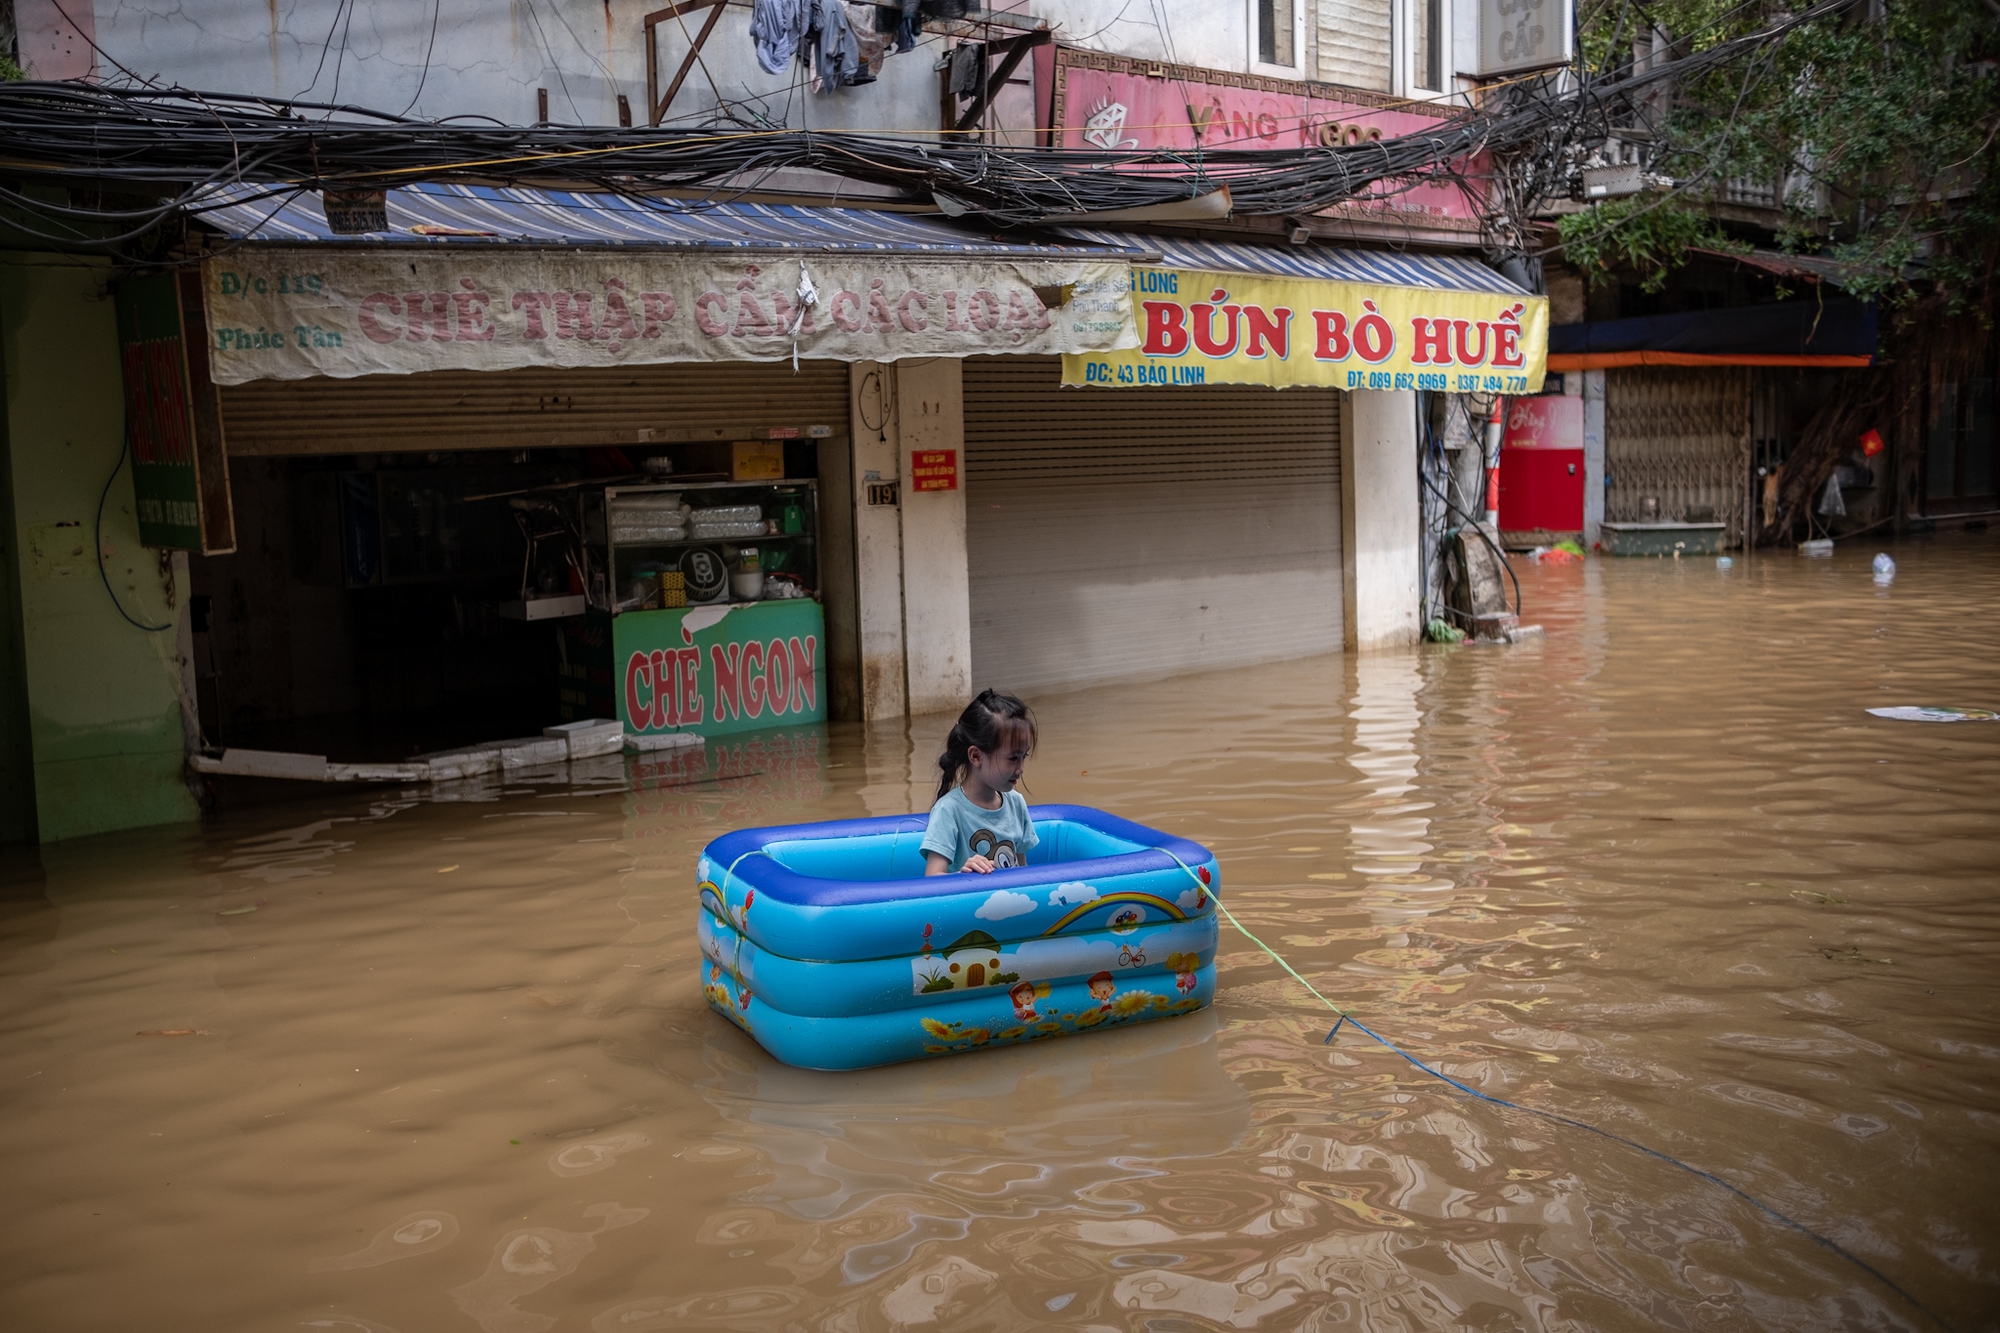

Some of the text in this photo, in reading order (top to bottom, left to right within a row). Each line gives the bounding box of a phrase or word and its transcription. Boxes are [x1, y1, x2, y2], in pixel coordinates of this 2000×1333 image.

[220, 272, 267, 299] Đ/c
[1140, 271, 1178, 294] LONG
[358, 276, 496, 343] CHÈ
[512, 276, 676, 354] THẬP
[831, 277, 928, 334] CÁC
[217, 325, 343, 350] Phúc Tân
[1141, 287, 1526, 370] BÚN BÒ HUẾ
[1086, 359, 1205, 384] ĐC: 43 BẢO LINH
[1348, 371, 1366, 388] ĐT:
[1369, 371, 1391, 389] 089
[1395, 373, 1414, 389] 662
[1418, 374, 1447, 389] 9969
[1458, 375, 1480, 390] 0387
[1483, 376, 1502, 391] 484
[1507, 376, 1527, 391] 770
[626, 626, 817, 731] CHÈ NGON
